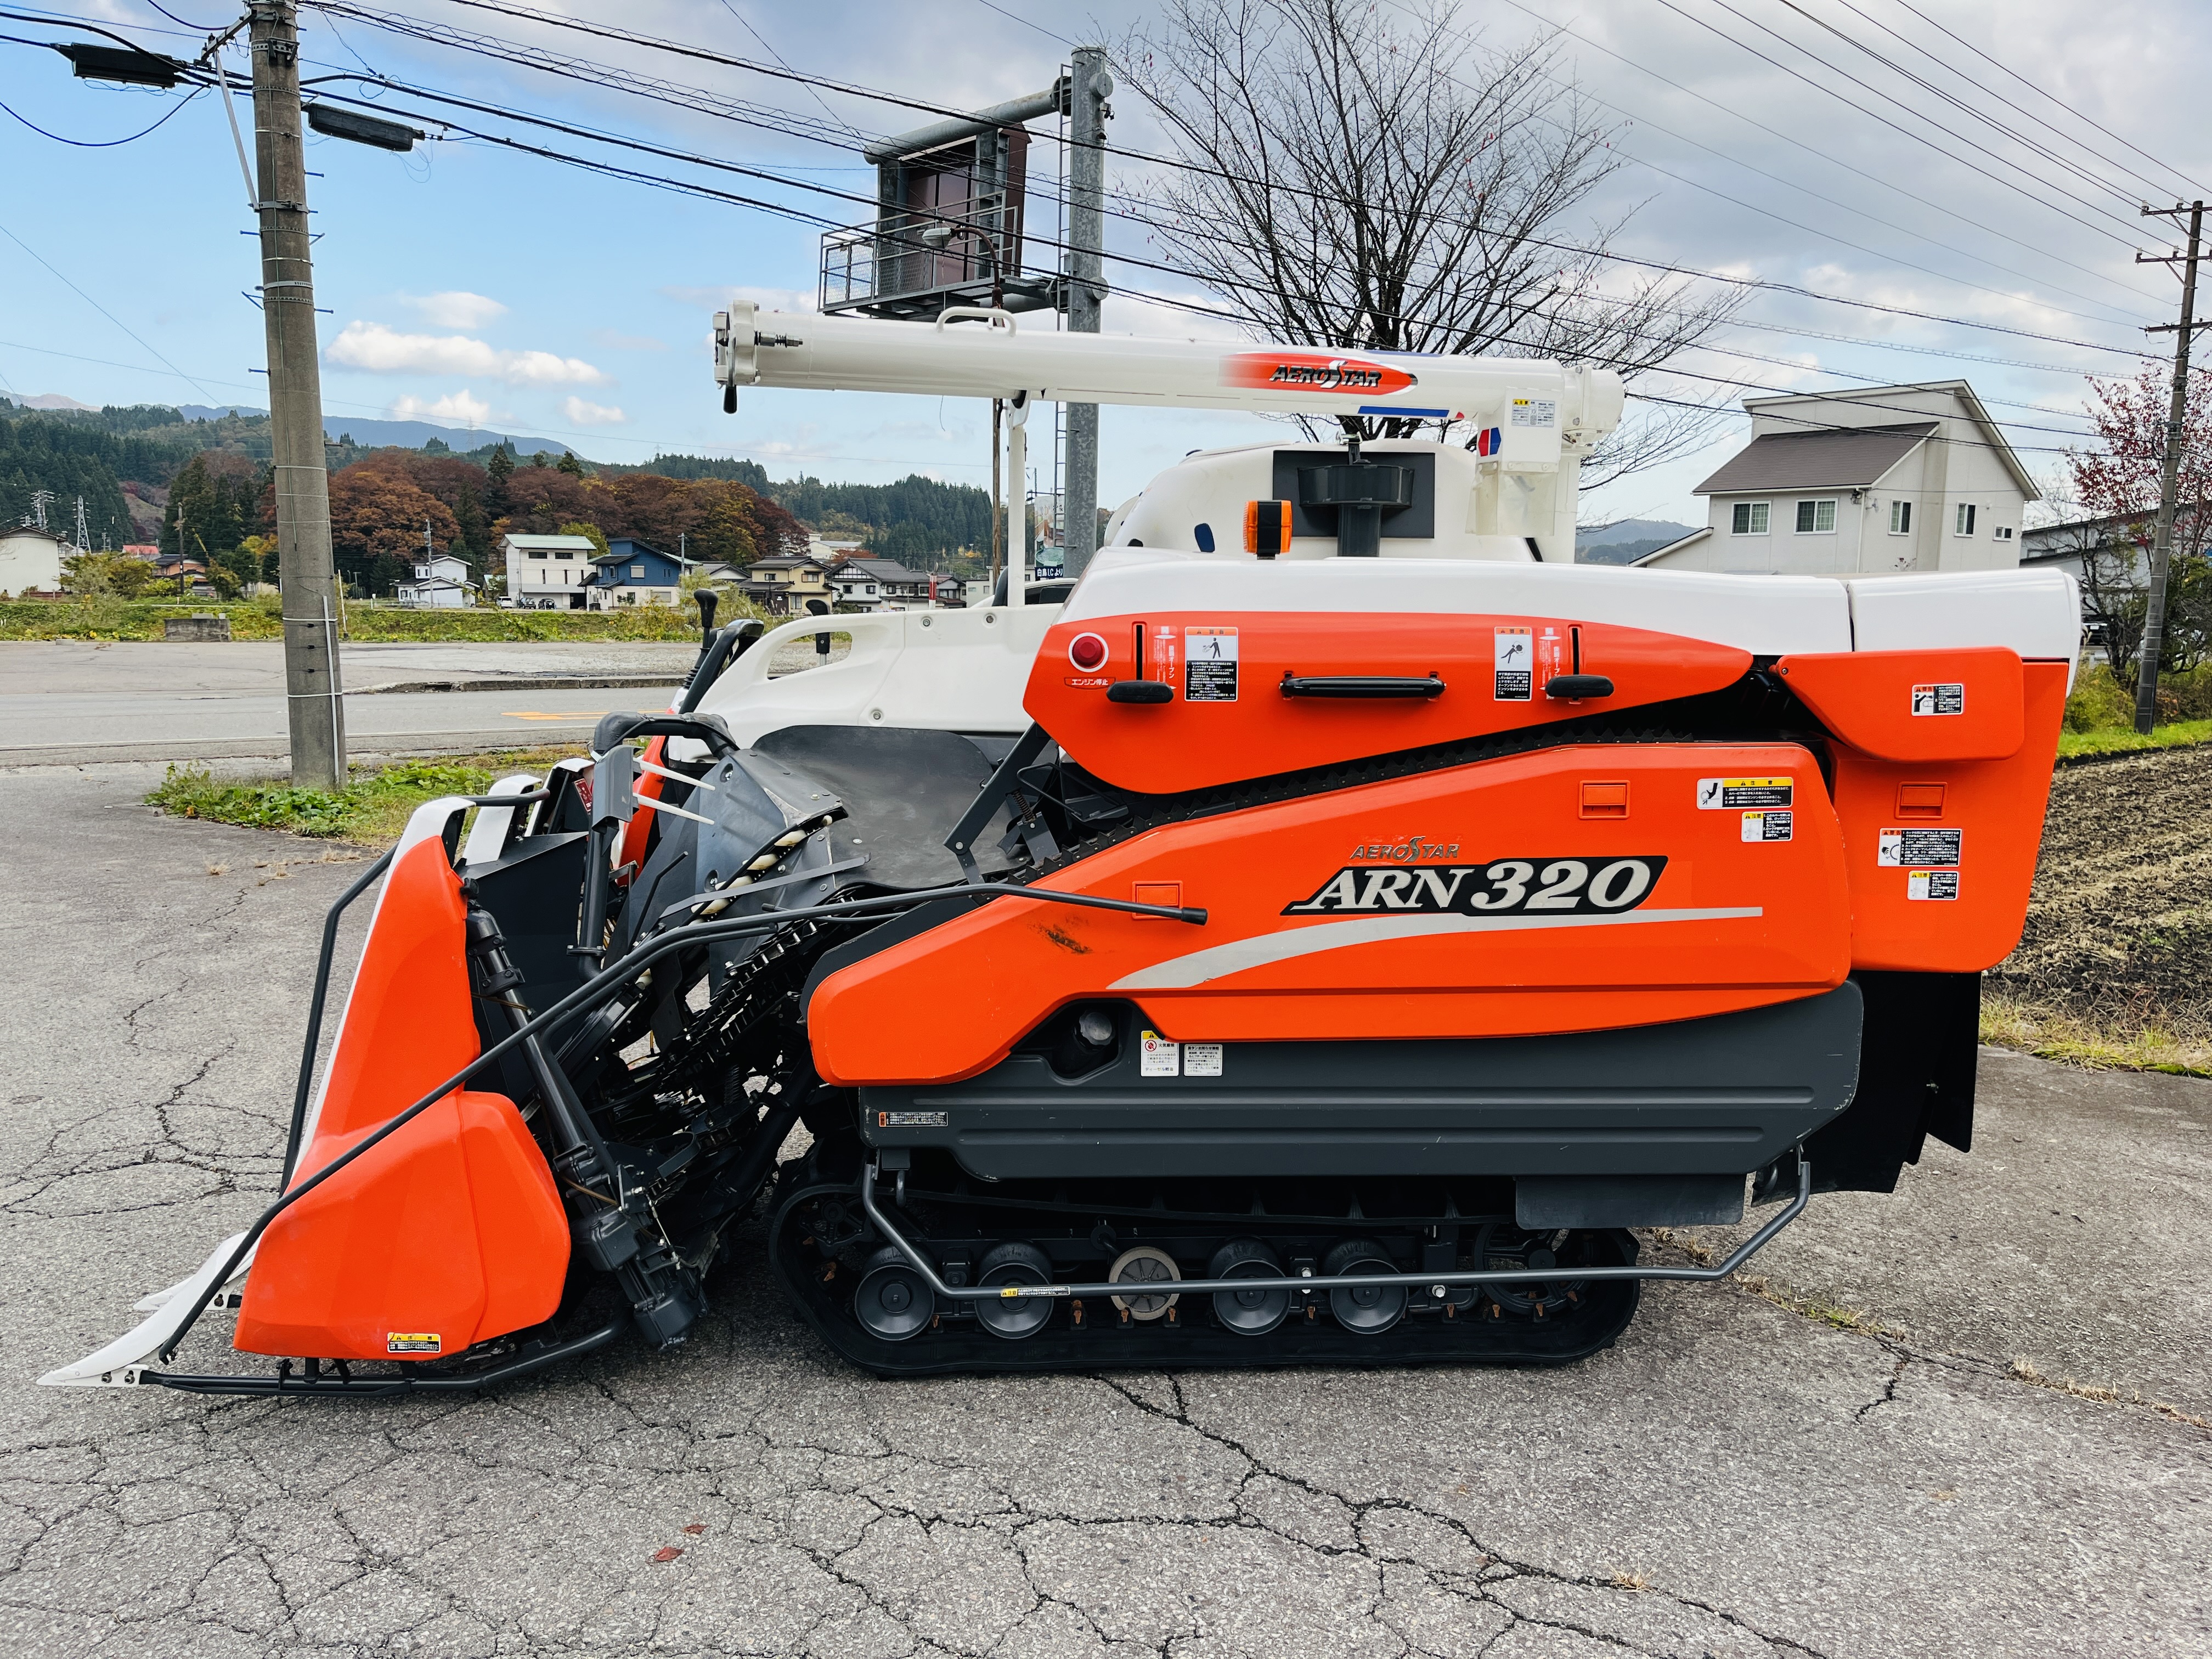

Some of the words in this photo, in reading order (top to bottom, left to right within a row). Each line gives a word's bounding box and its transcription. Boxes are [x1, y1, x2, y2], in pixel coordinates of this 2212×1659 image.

[1269, 360, 1383, 389] AEROSTAR
[1349, 836, 1460, 863] AEROSTAR
[1290, 868, 1474, 910] ARN
[1470, 860, 1651, 910] 320
